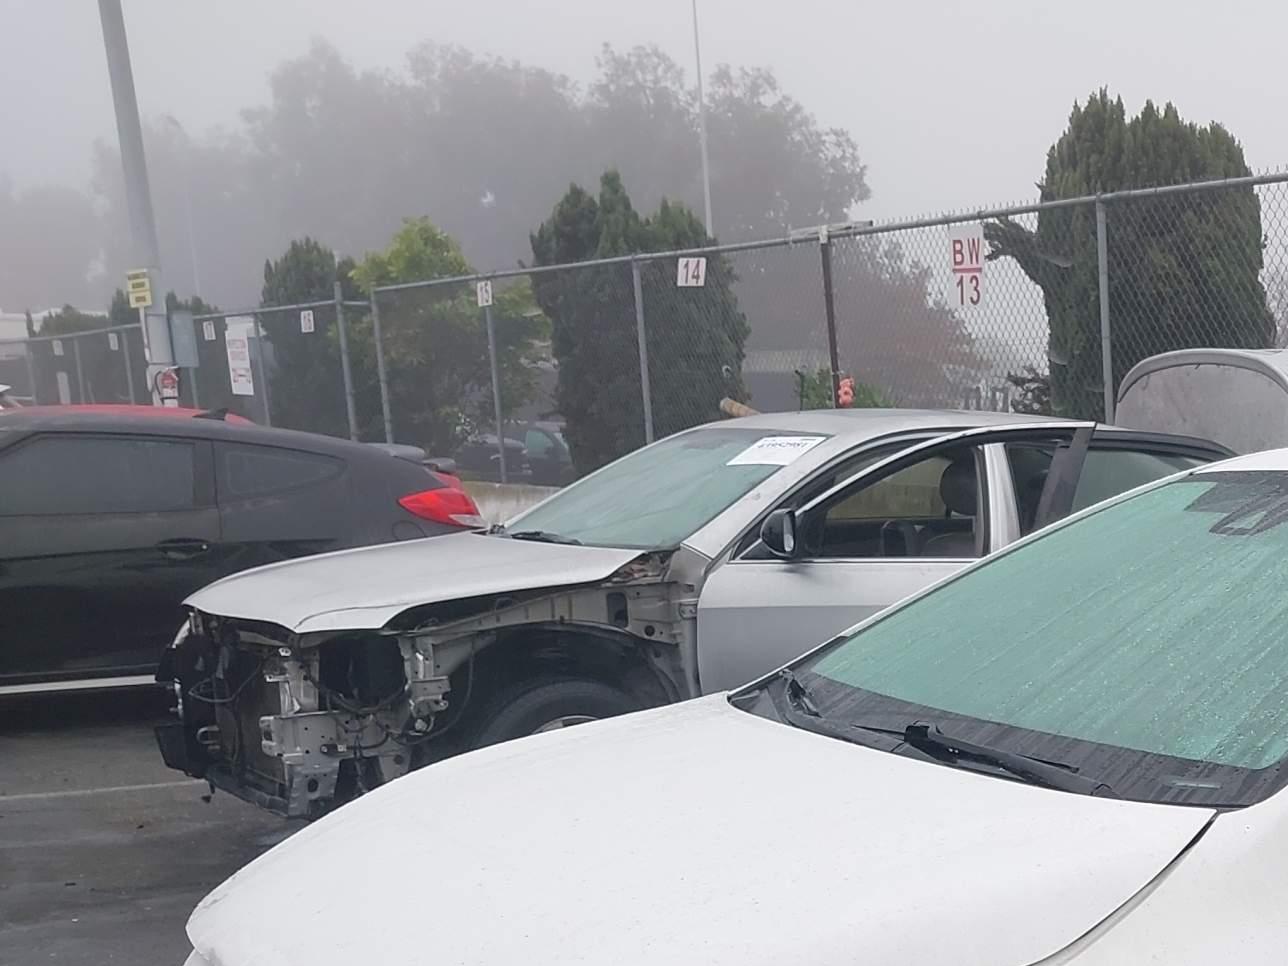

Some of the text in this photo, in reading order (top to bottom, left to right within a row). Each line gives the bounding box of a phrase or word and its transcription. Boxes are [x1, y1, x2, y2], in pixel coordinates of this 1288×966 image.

[952, 237, 981, 266] BW
[683, 259, 701, 284] 14
[479, 282, 490, 304] 15
[956, 274, 981, 306] 13
